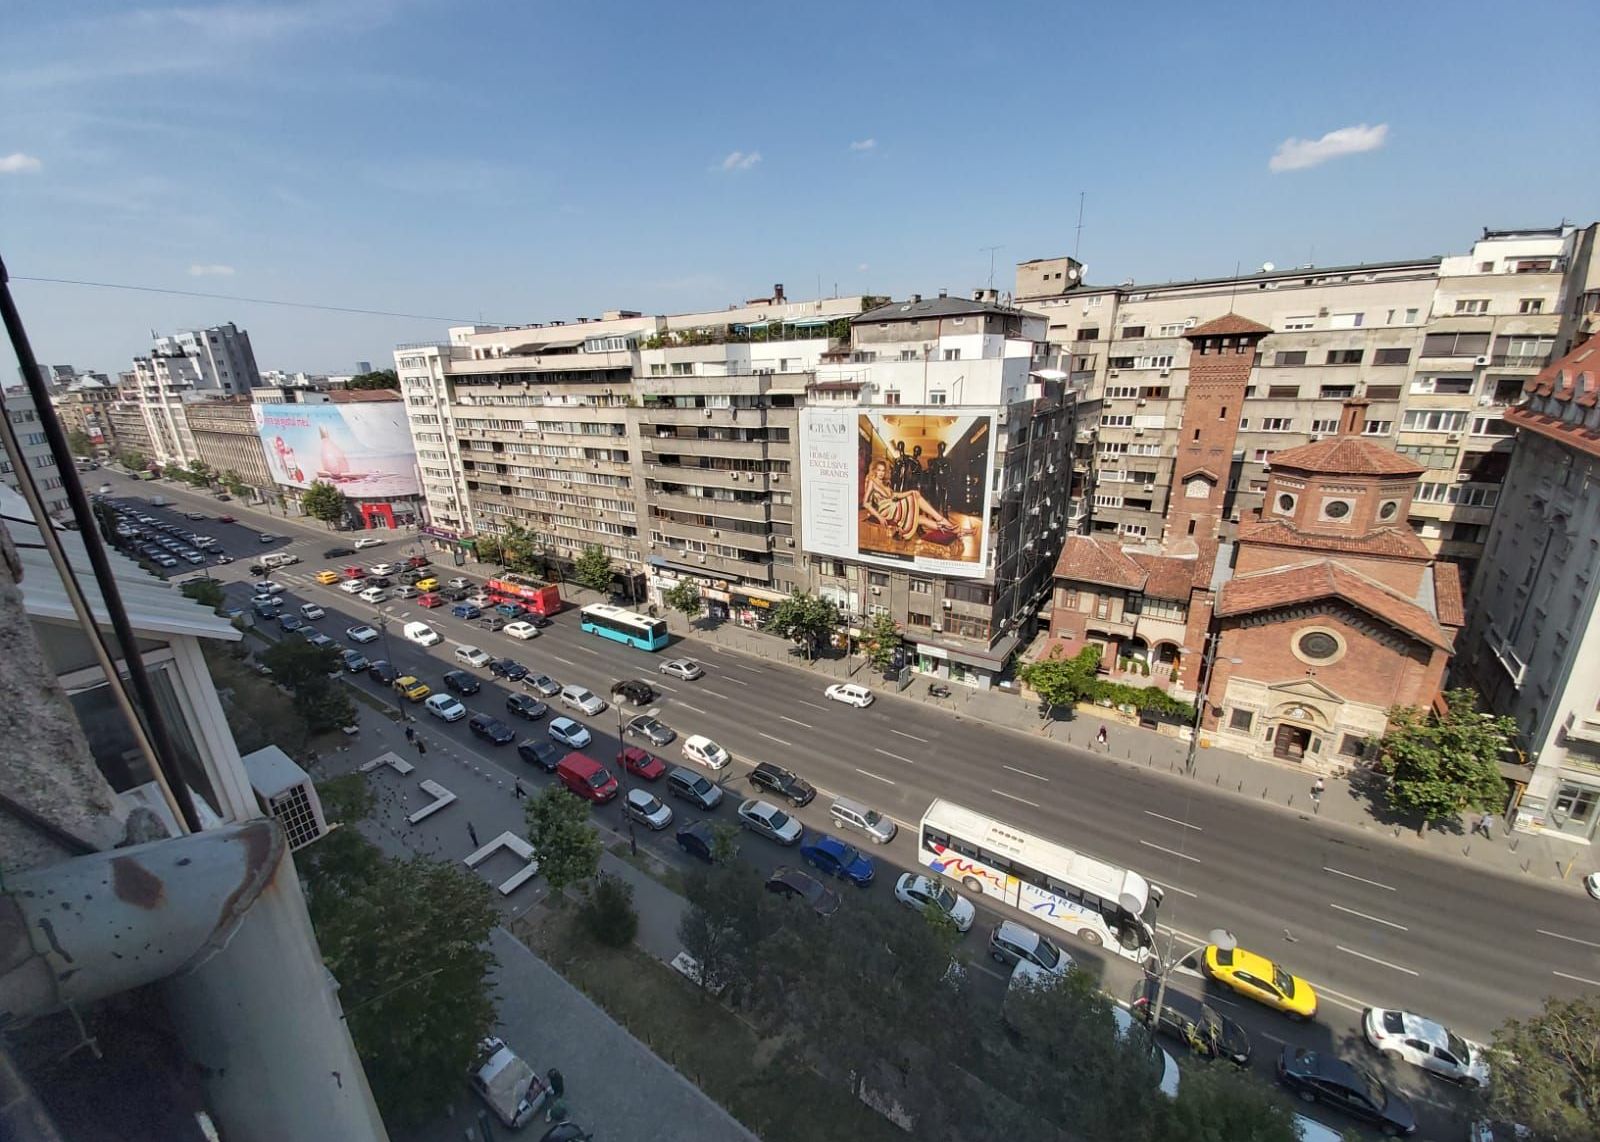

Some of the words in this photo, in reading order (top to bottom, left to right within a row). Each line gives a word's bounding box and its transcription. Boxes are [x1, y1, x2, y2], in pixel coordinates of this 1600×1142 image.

[809, 423, 846, 434] GRAND
[809, 451, 829, 459] HOME
[809, 460, 848, 469] EXCLUSIVE
[820, 469, 849, 478] BRANDS
[1026, 885, 1085, 913] FILARET
